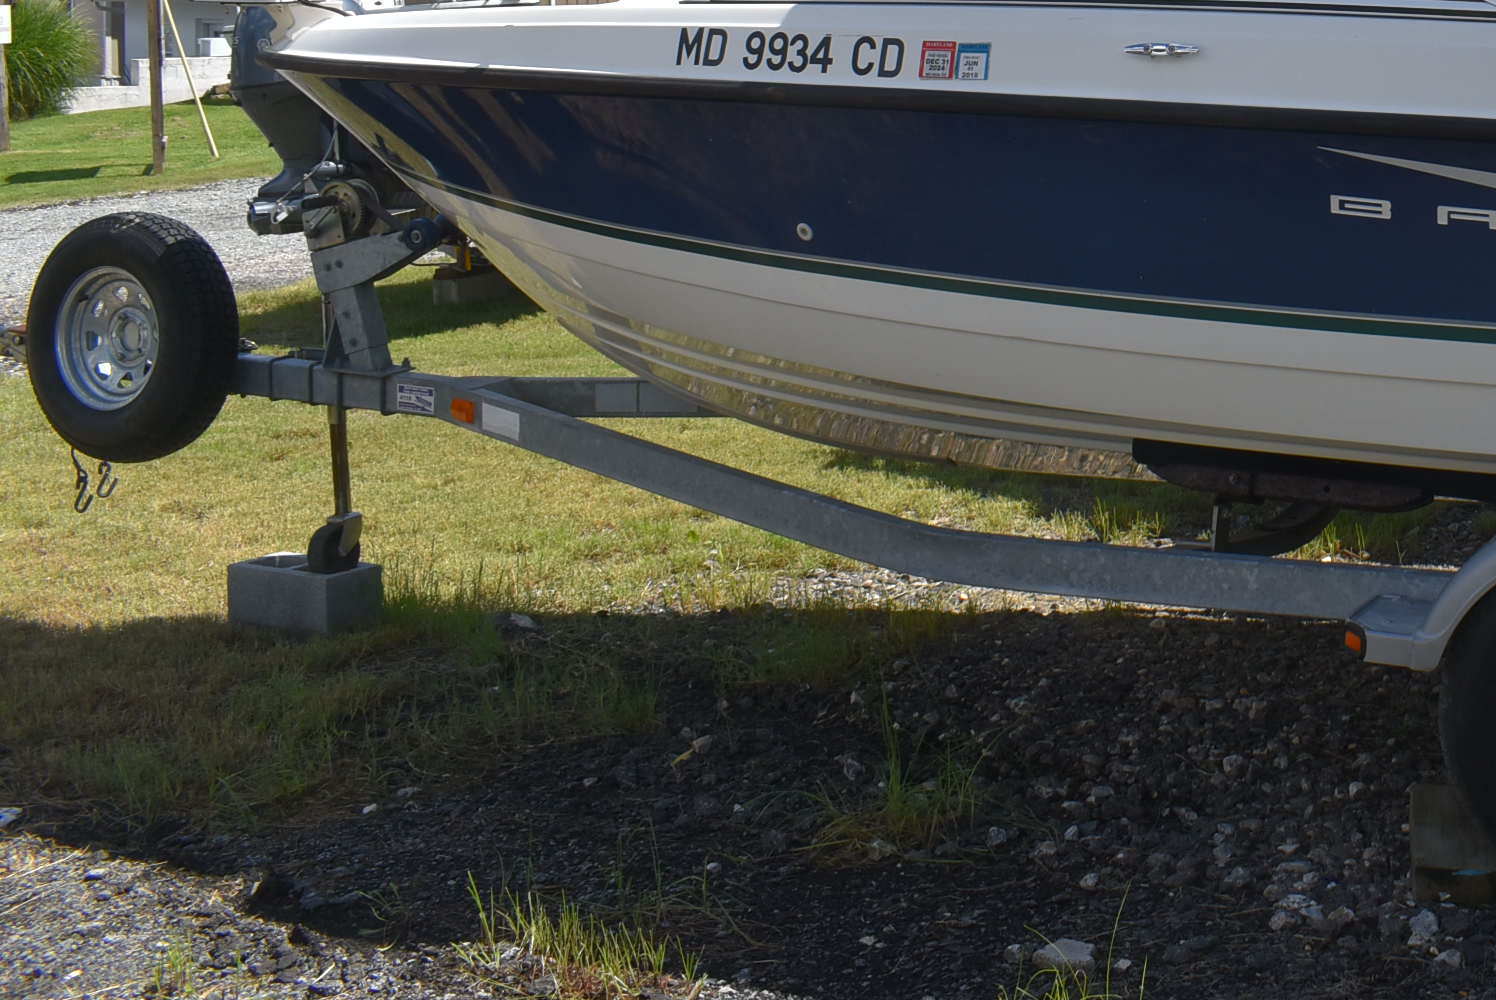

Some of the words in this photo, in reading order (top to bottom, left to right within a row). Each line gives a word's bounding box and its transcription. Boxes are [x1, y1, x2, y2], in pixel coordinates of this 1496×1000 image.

[676, 27, 728, 67] MD
[742, 31, 833, 74] 9934
[852, 35, 905, 78] CD
